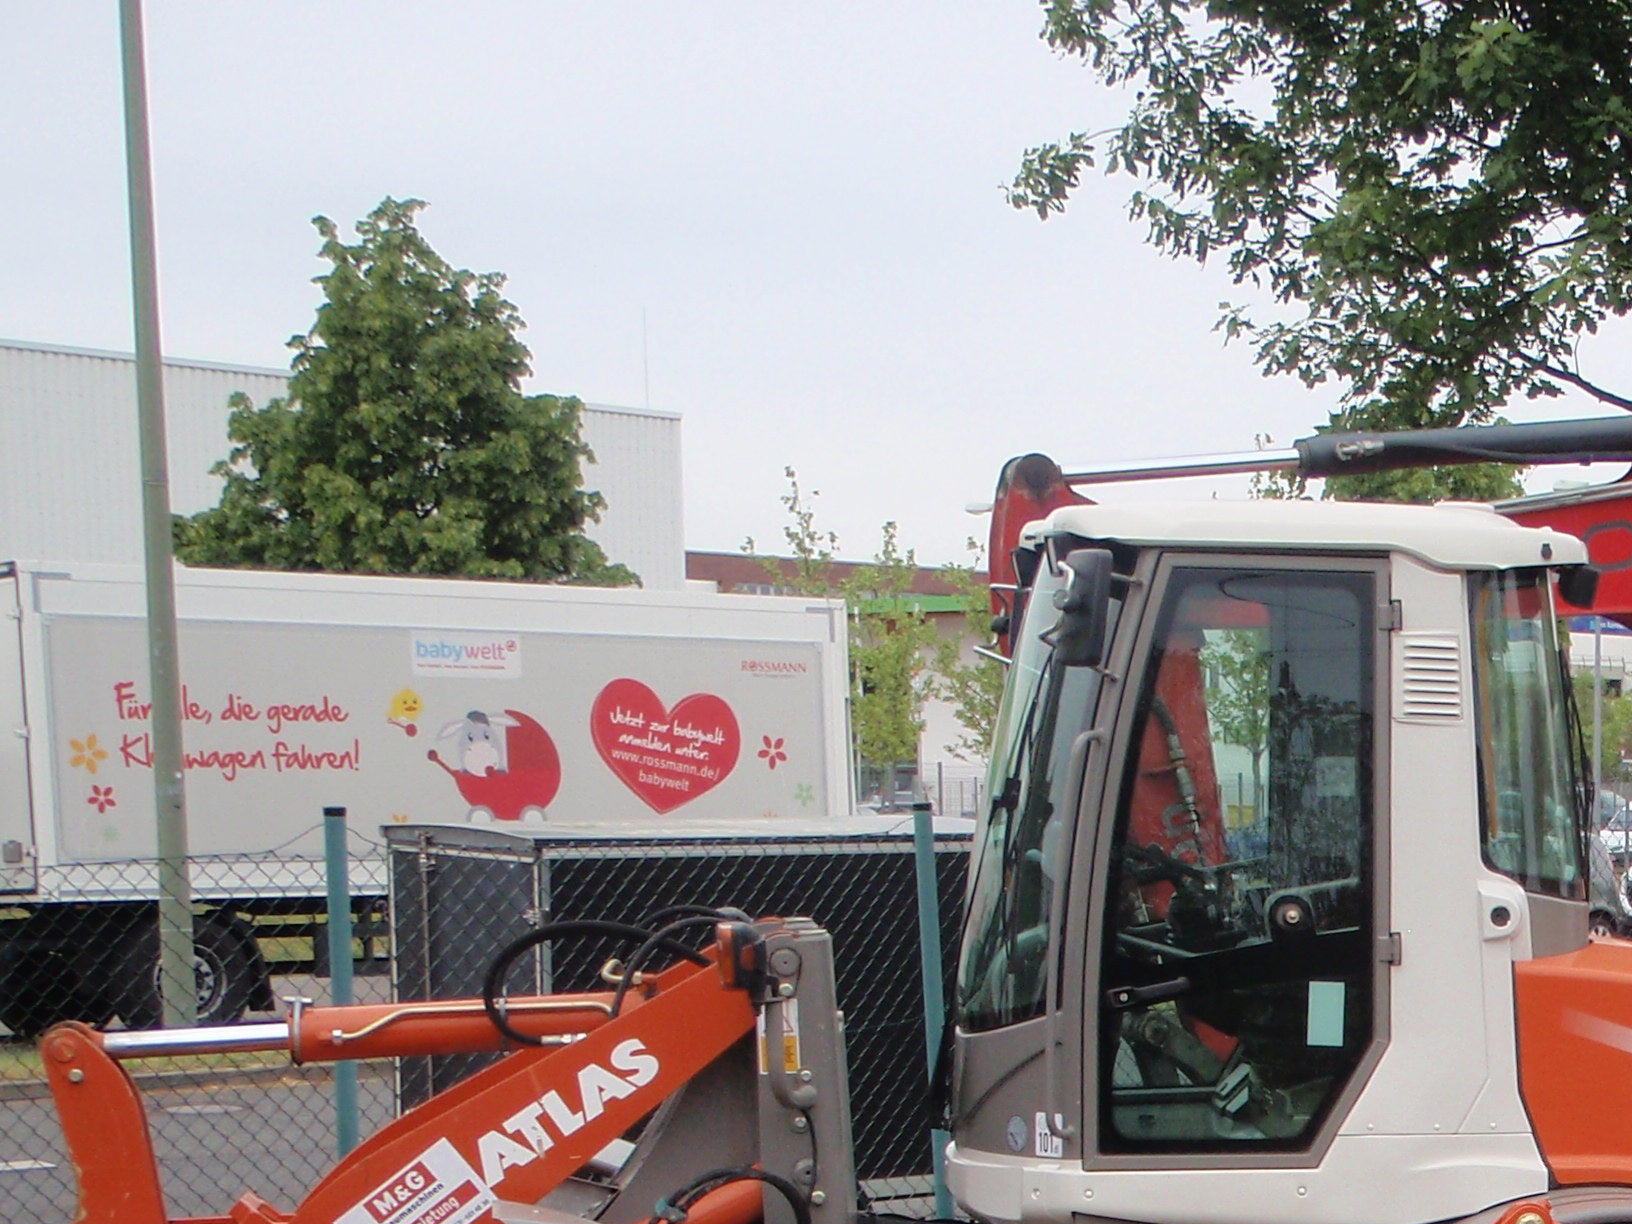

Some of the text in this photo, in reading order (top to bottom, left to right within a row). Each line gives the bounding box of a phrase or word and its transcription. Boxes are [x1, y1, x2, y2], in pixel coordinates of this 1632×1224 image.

[415, 640, 506, 661] babywelt
[113, 681, 152, 720] Für
[221, 694, 261, 721] die
[267, 695, 349, 734] gerade
[610, 705, 726, 746] Jetzt zur babywelt
[618, 731, 671, 753] anmelden
[271, 738, 360, 773] fahren!
[611, 749, 721, 780] www.rossmann.de/
[638, 769, 690, 791] babywelt
[477, 1038, 660, 1187] ATLAS
[372, 1170, 426, 1217] M&G
